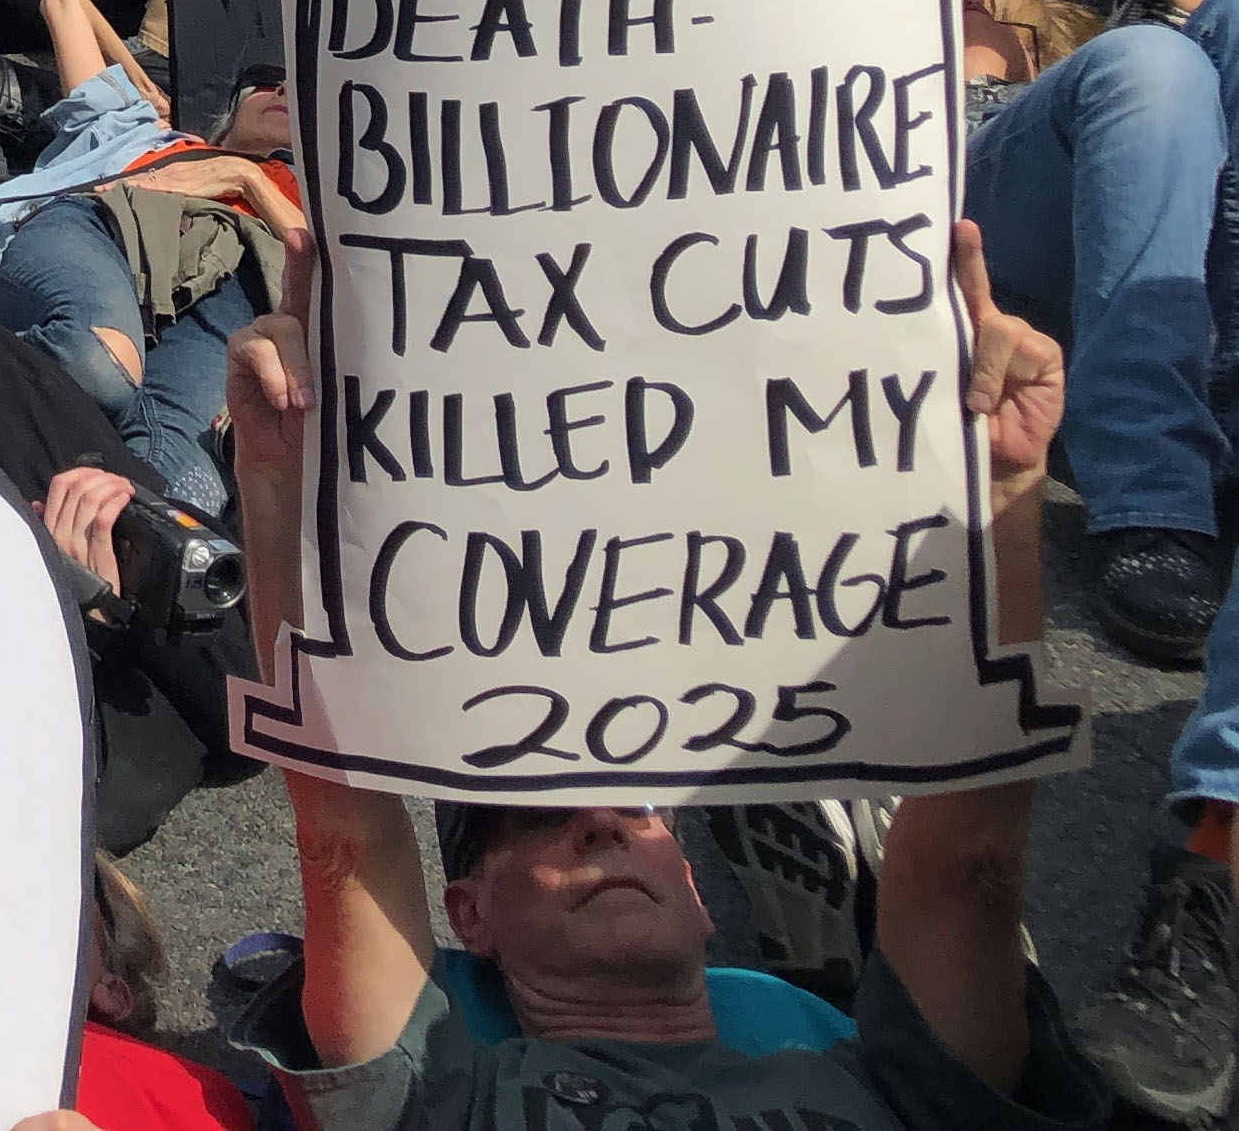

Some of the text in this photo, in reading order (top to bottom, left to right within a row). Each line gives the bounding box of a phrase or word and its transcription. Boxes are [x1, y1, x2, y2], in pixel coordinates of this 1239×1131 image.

[337, 63, 948, 215] BILLIONAIRE
[339, 214, 934, 355] TAX CUTS
[344, 368, 938, 493] KILLED MY
[369, 514, 952, 663] COVERAGE
[462, 681, 851, 769] 2025
